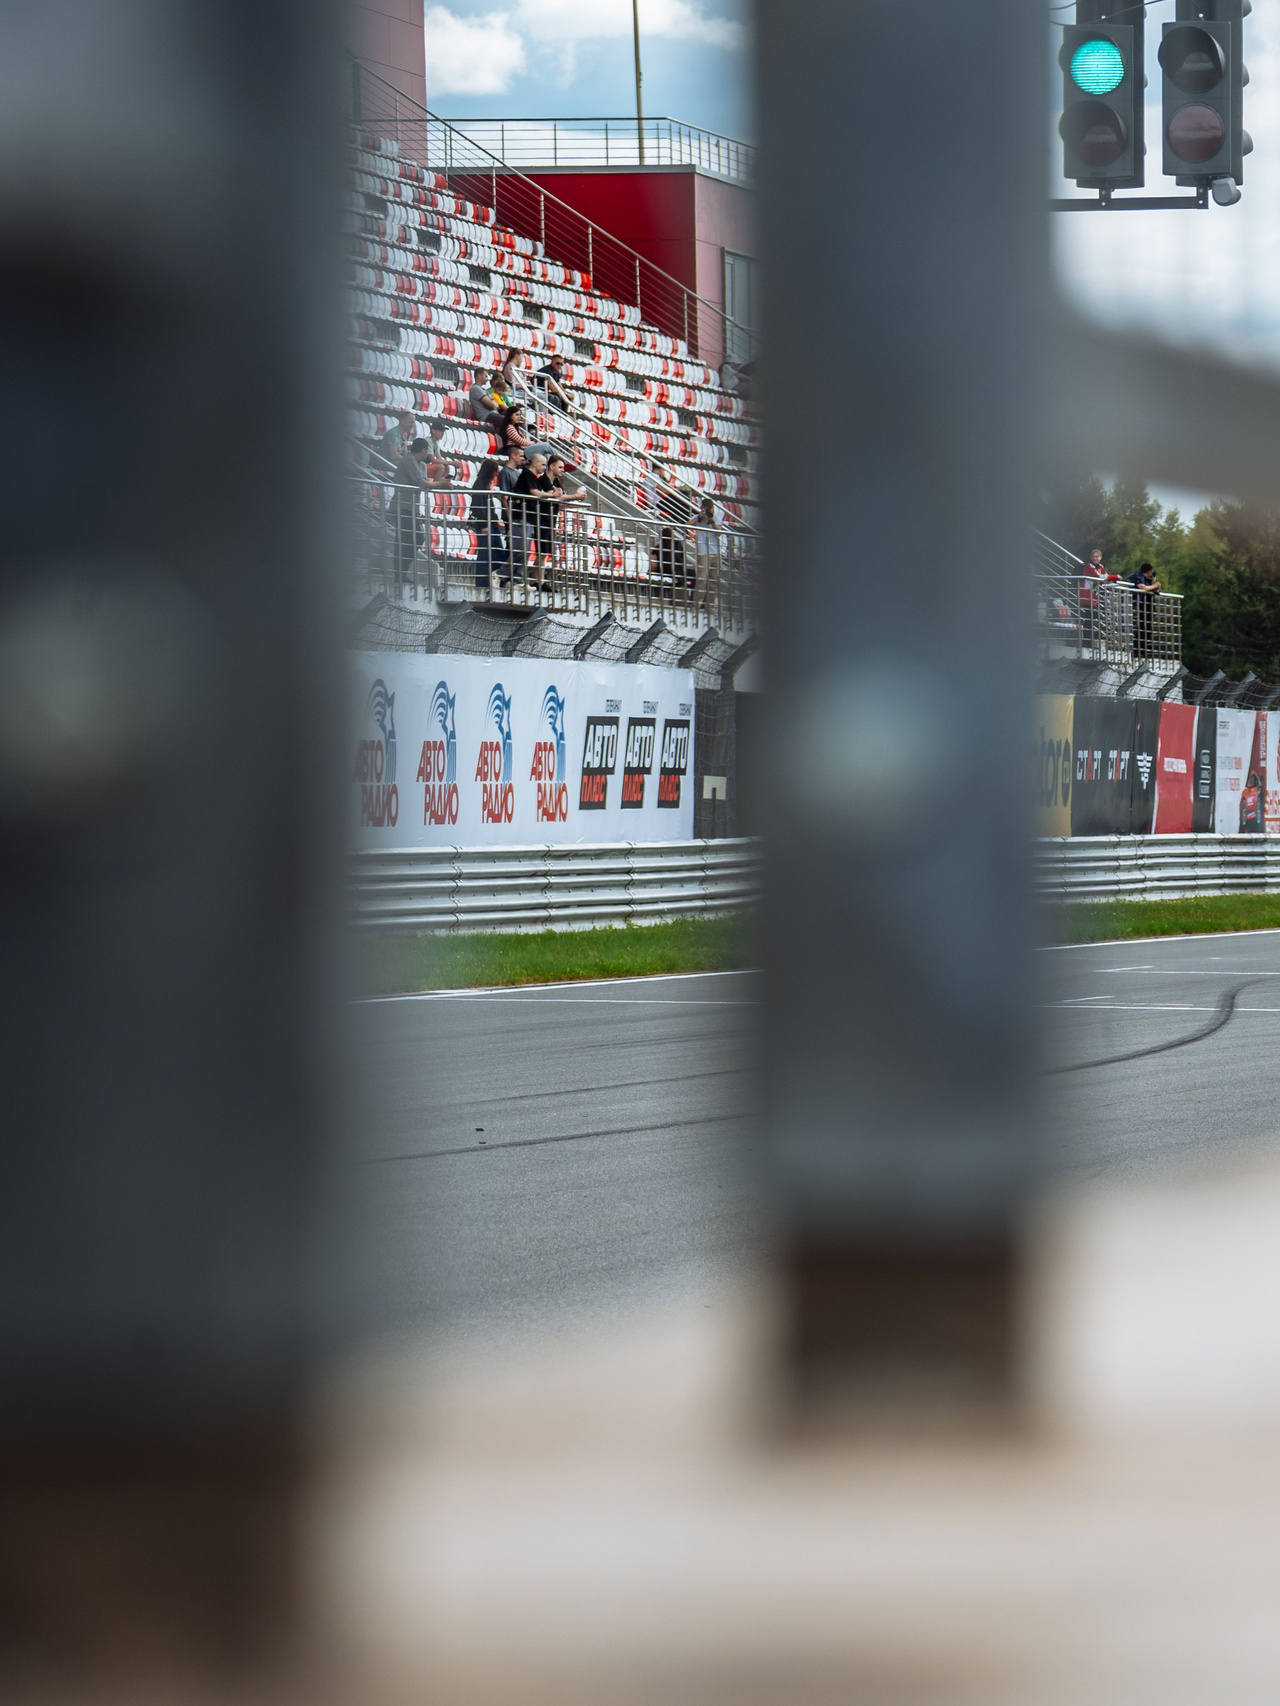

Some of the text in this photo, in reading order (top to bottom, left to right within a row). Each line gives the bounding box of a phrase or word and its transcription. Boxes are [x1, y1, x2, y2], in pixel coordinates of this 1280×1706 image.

[352, 739, 384, 783] АВТО
[416, 740, 445, 783] АВТО
[475, 741, 501, 782] АВТО
[530, 741, 555, 781] АВТО
[583, 724, 618, 769] АВТО
[625, 725, 655, 769] АВТО
[661, 726, 689, 769] АВТО
[361, 783, 399, 828] РАДИО
[424, 782, 459, 826] РАДИО
[482, 782, 514, 823] РАДИО
[536, 782, 568, 822] РАДИО
[581, 774, 606, 803] ПЛЮС
